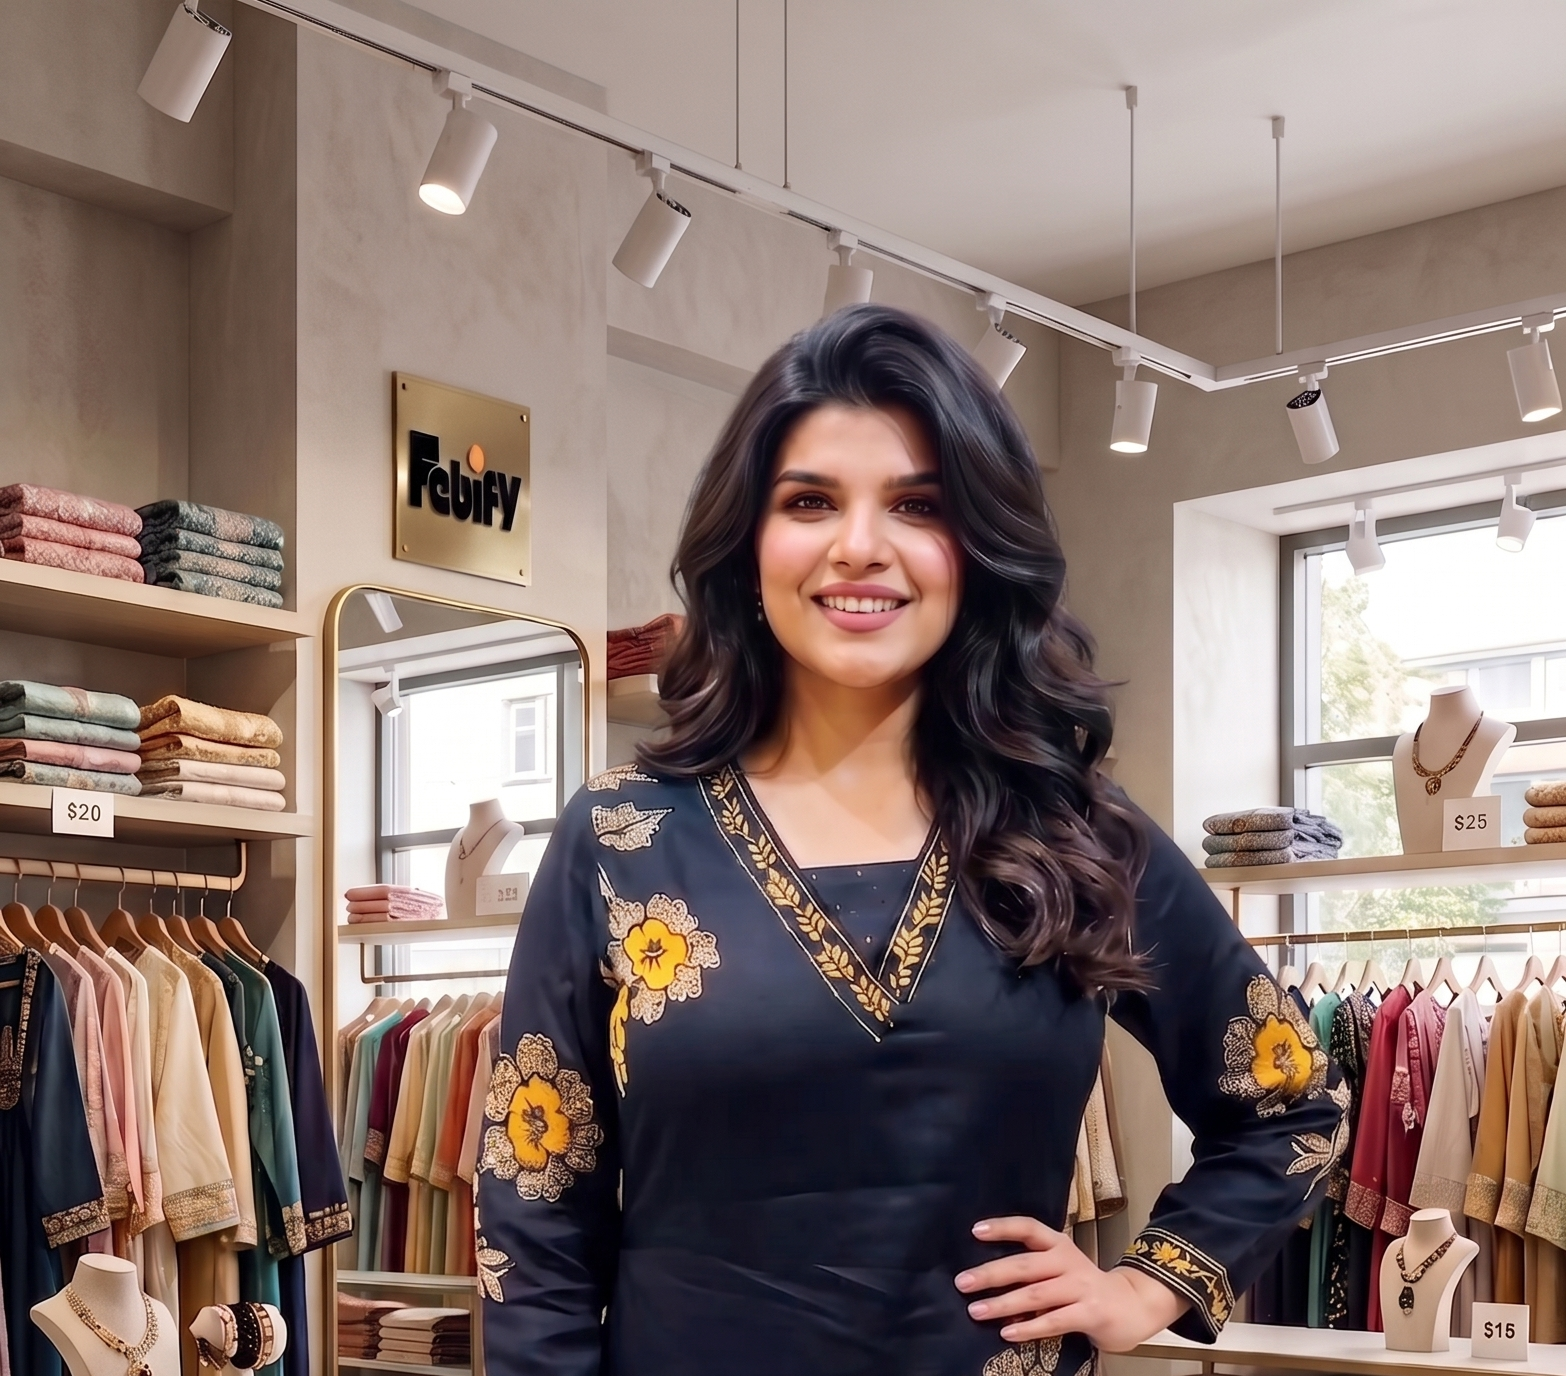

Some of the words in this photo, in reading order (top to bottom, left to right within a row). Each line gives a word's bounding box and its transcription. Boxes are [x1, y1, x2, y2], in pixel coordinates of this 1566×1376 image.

[67, 802, 101, 822] $20
[1454, 814, 1487, 831] $25
[1484, 1321, 1515, 1339] $15
